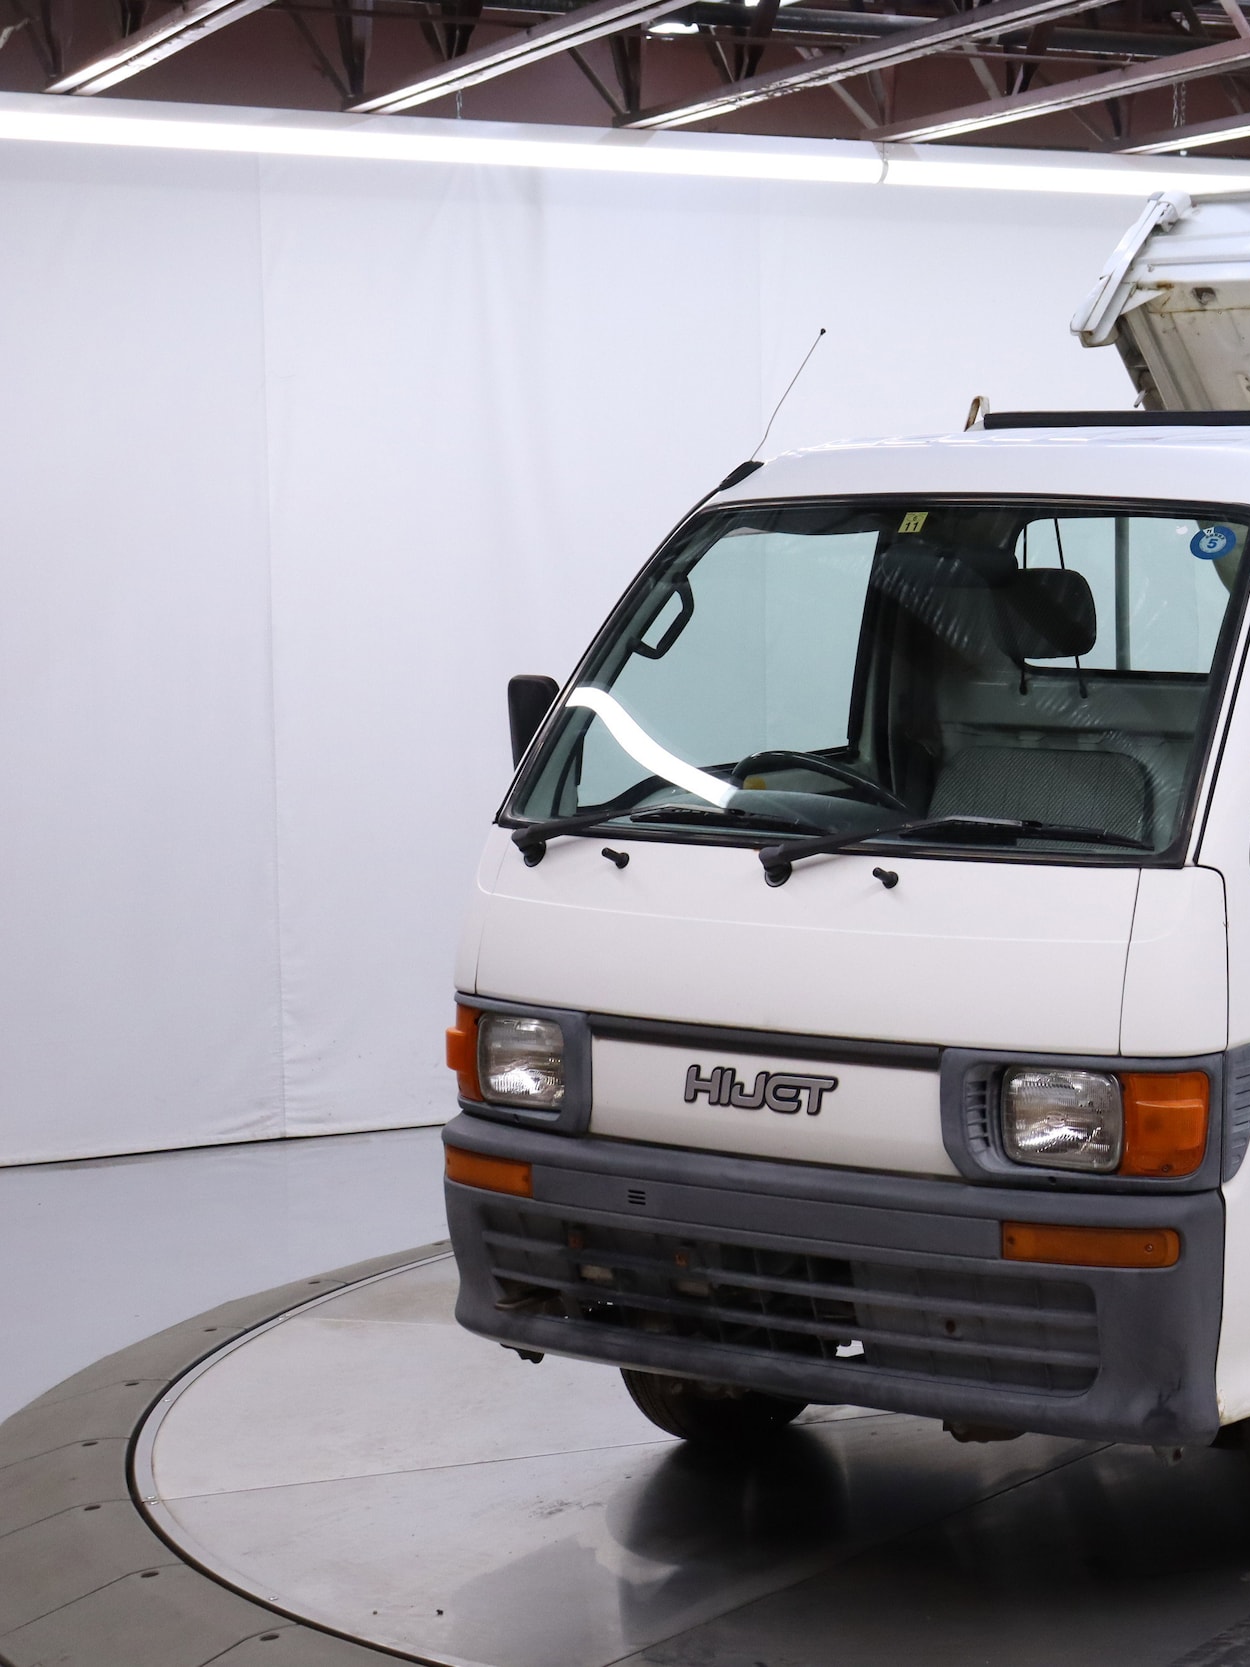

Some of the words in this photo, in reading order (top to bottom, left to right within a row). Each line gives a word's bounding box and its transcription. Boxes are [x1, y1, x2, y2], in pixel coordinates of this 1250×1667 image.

[905, 522, 919, 532] 11
[1207, 538, 1219, 549] 5
[684, 1064, 839, 1116] HIJET
